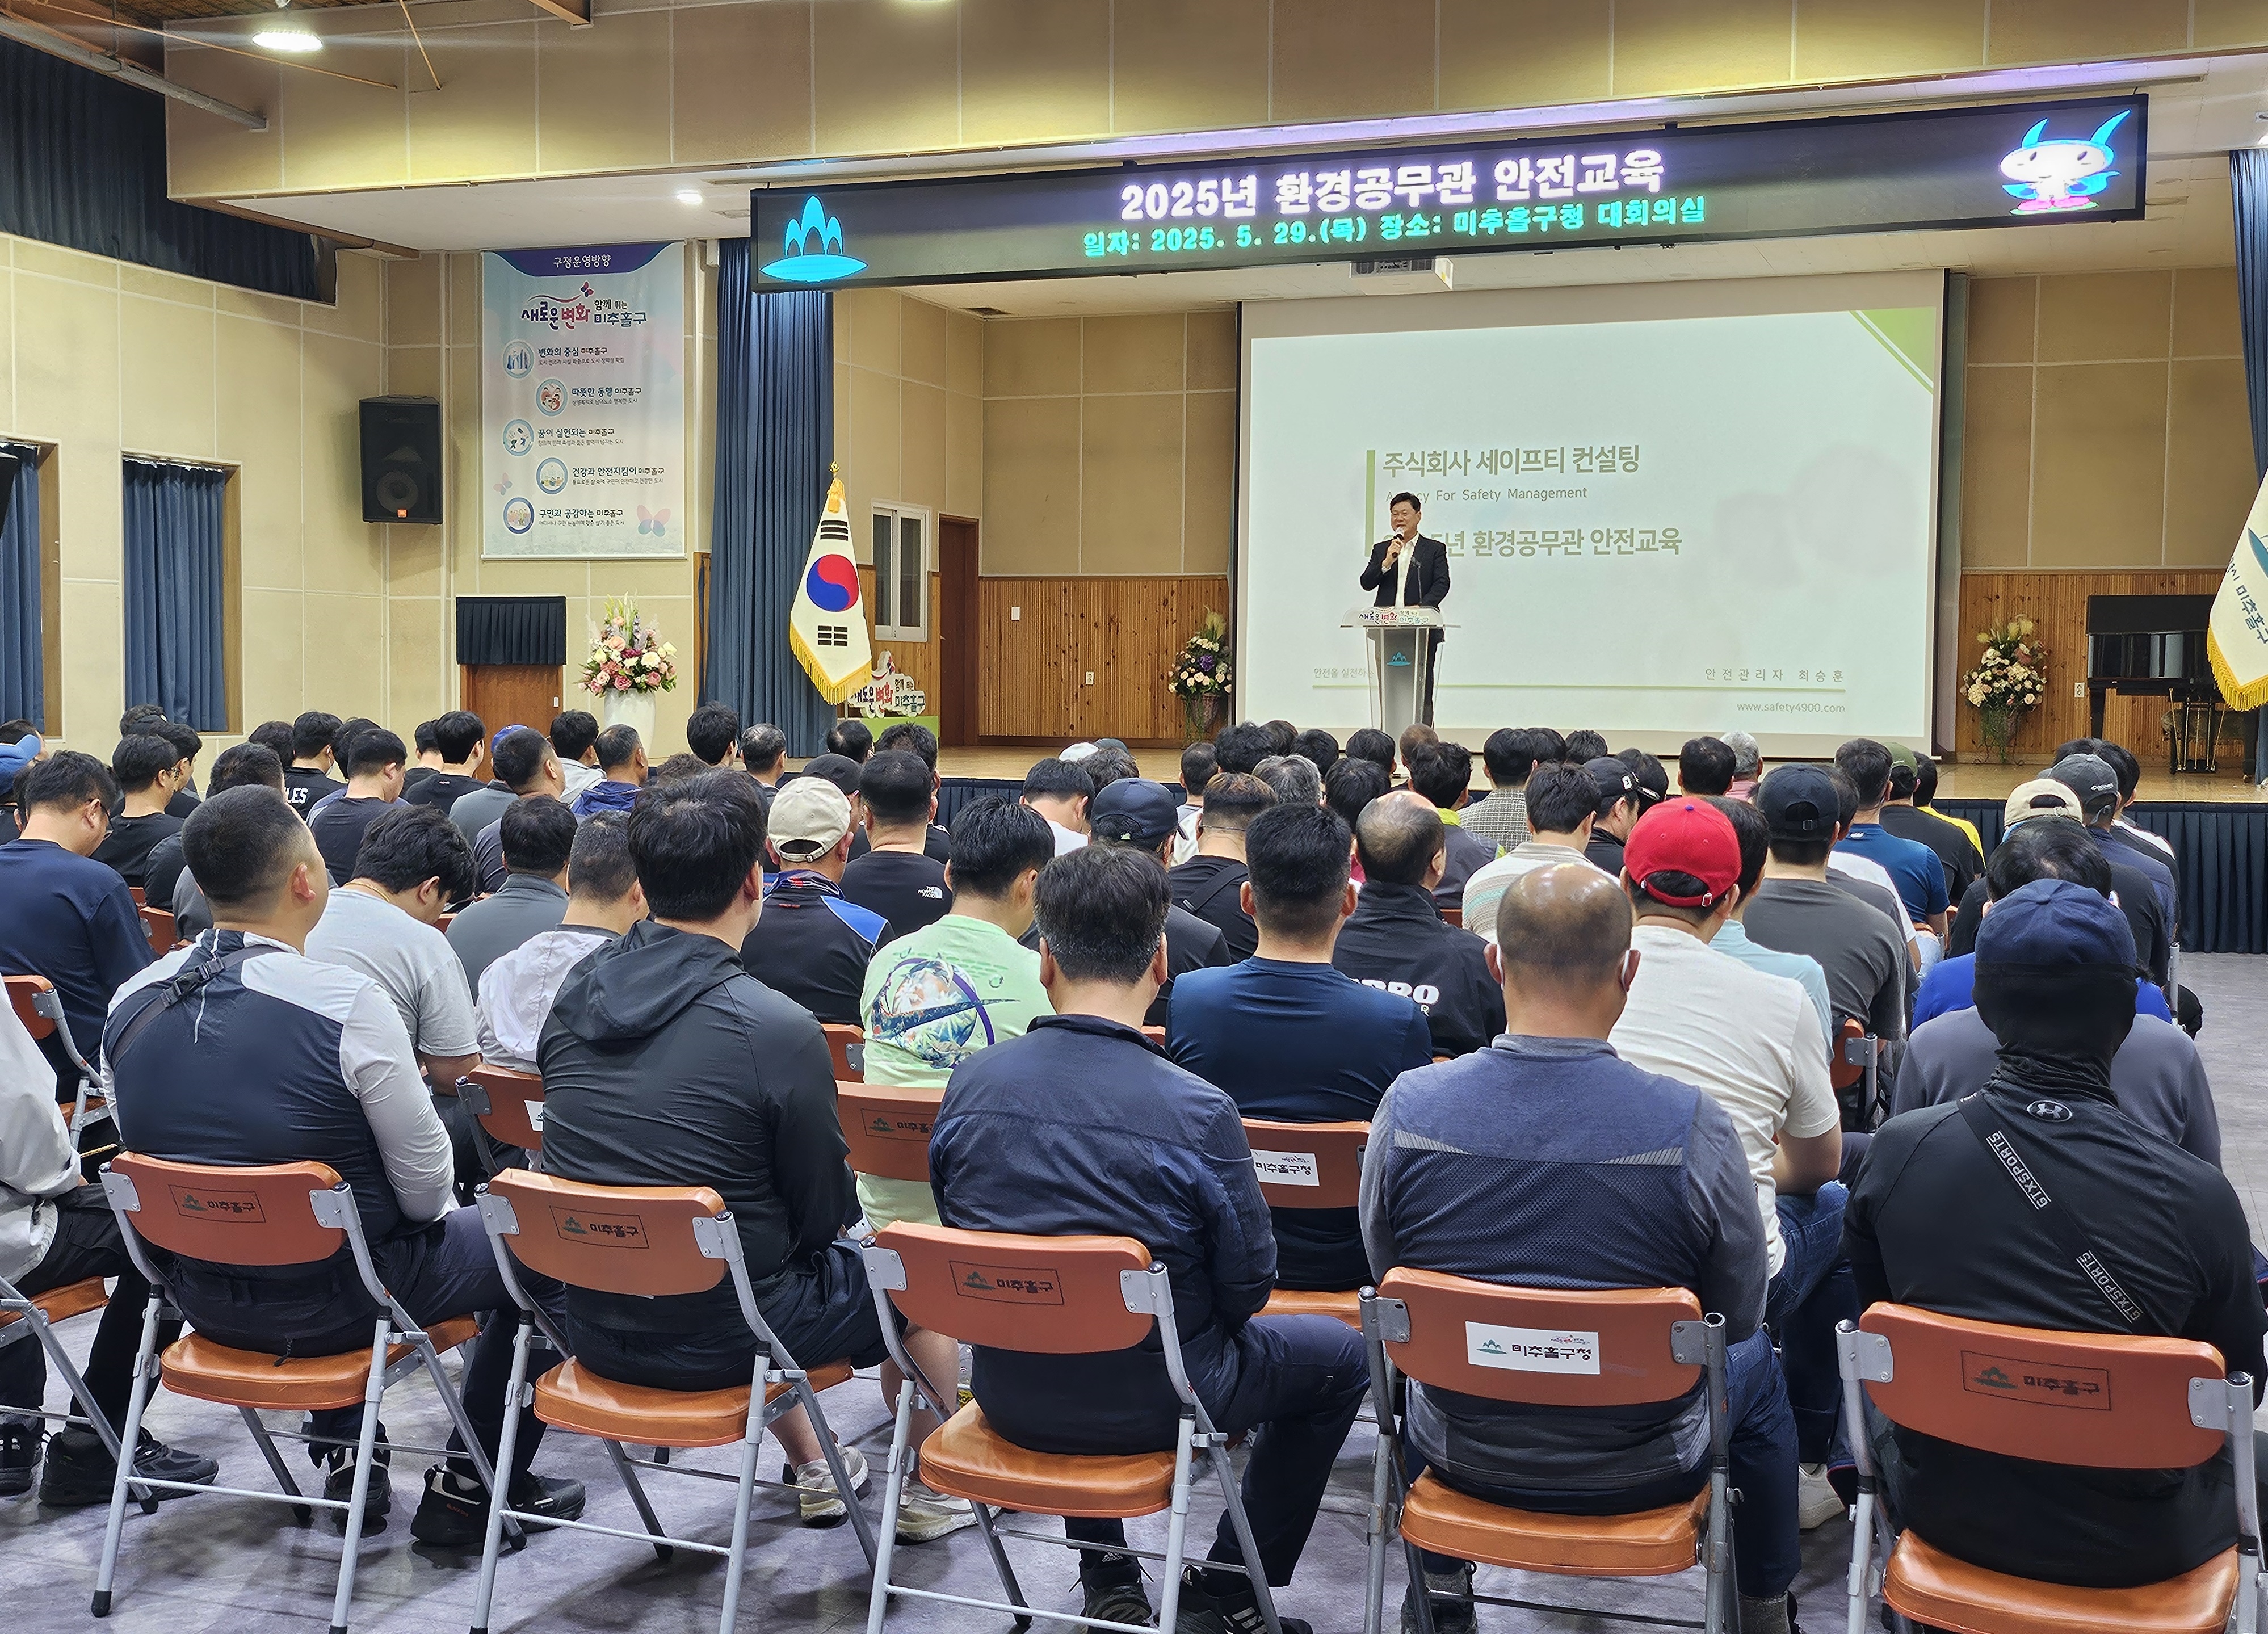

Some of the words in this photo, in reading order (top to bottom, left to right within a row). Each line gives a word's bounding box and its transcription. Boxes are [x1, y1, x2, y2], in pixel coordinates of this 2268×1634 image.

[1121, 175, 1257, 220] 2025년
[1275, 162, 1476, 215] 환경공무관
[1494, 149, 1664, 200] 안전교육
[1084, 230, 1140, 257] 일자:
[1151, 226, 1225, 251] 2025.
[1236, 225, 1261, 247] 5.
[1274, 217, 1368, 245] 29.(목)
[1379, 213, 1441, 240] 장소:
[1454, 203, 1584, 236] 미추홀구청
[1597, 196, 1705, 227] 대회의실
[553, 254, 611, 268] 구정운영방향
[594, 312, 647, 327] 미추홀구
[1383, 450, 1471, 478] 주식회사
[1476, 447, 1565, 476] 세이프티
[1572, 445, 1640, 473] 컨설팅
[1436, 490, 1456, 501] For
[1462, 488, 1501, 502] Safety
[1507, 486, 1588, 501] Management
[1472, 528, 1584, 558] 환경공무관
[1590, 527, 1683, 556] 안전교육
[2236, 585, 2268, 644] 미추홀구
[1737, 702, 1845, 713] www.safety4900.com
[284, 787, 309, 804] LES
[1255, 1162, 1312, 1175] 미추홀구청
[1988, 1133, 2048, 1208] GTXSPORTS
[2079, 1252, 2140, 1321] GTXSPORTS
[1512, 1344, 1591, 1360] 미추홀구청
